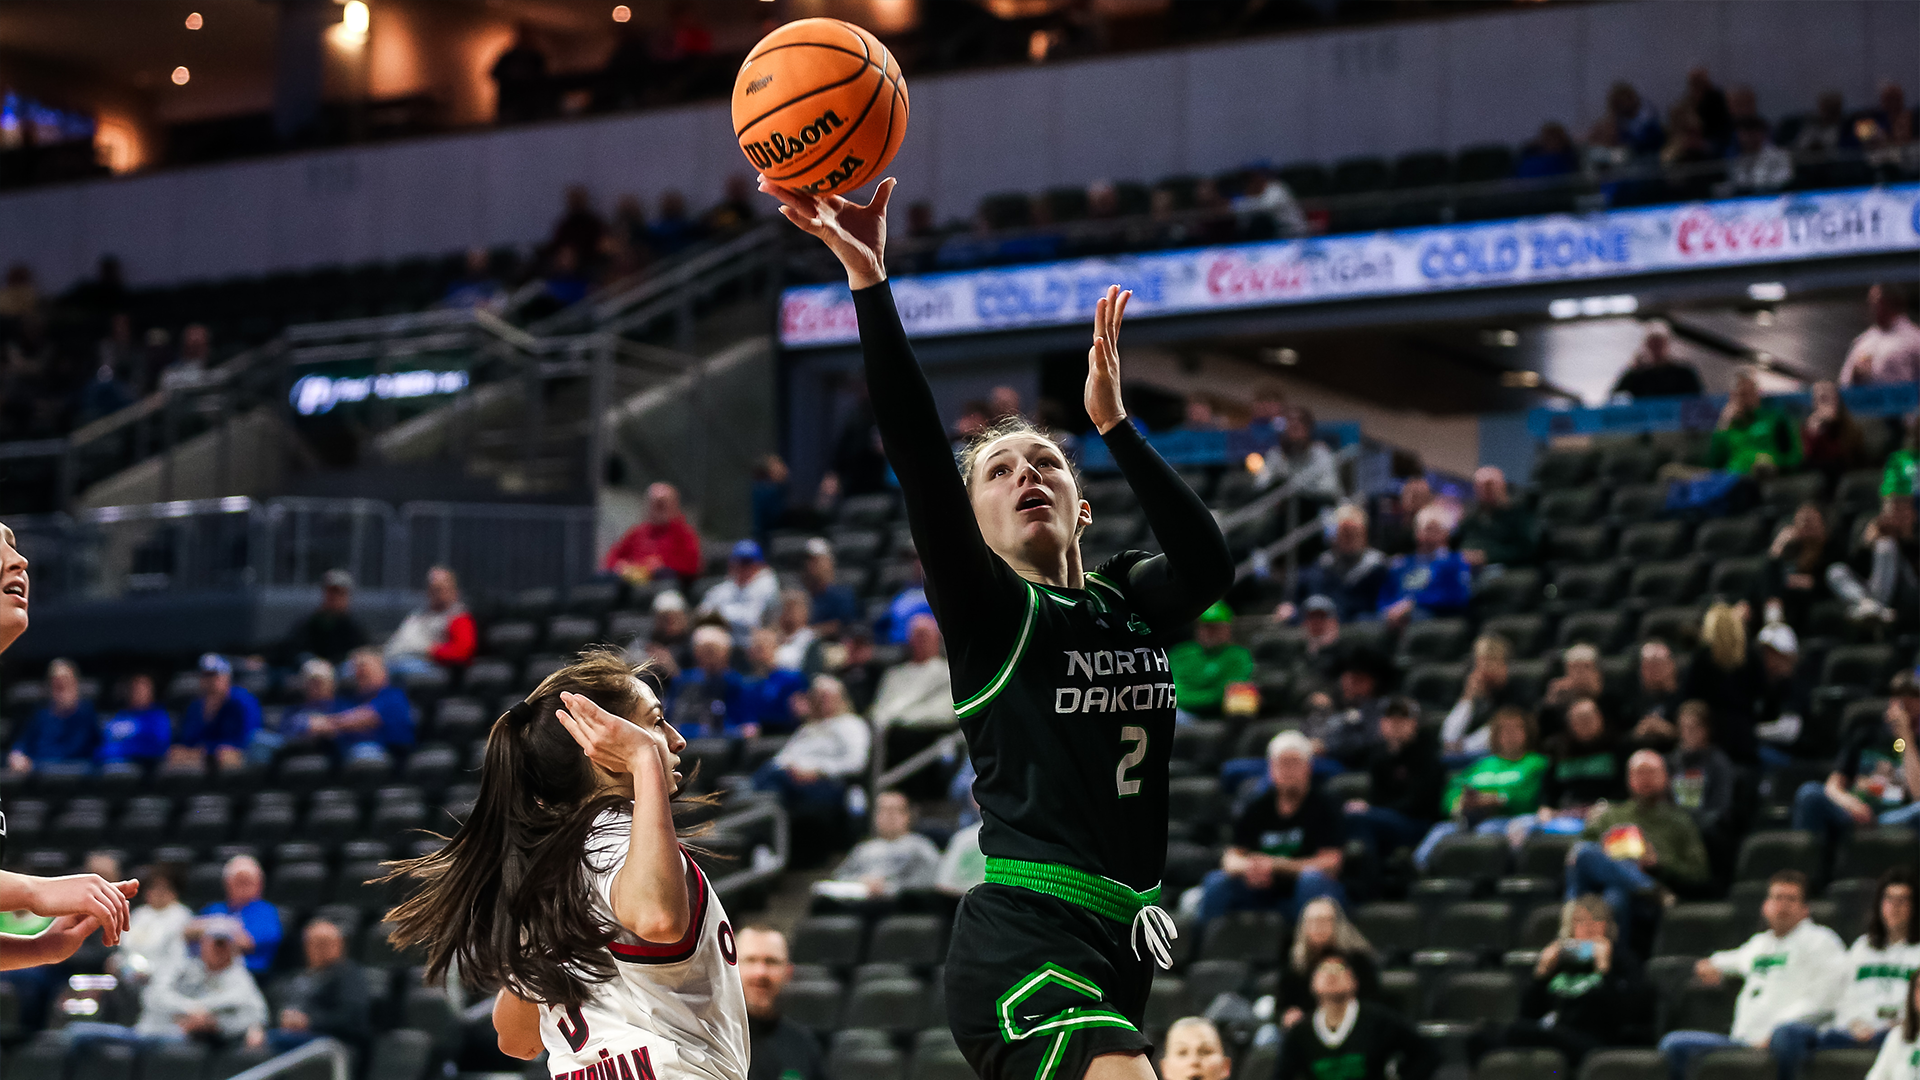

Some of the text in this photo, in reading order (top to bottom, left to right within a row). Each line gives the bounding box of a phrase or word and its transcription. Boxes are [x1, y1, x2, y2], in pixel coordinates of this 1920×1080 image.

[744, 109, 844, 170] Wilson
[1420, 233, 1521, 281] COLD
[1530, 224, 1630, 271] ZONE
[1063, 647, 1170, 682] NORTH
[1055, 682, 1177, 714] DAKOTA
[1116, 724, 1149, 799] 2
